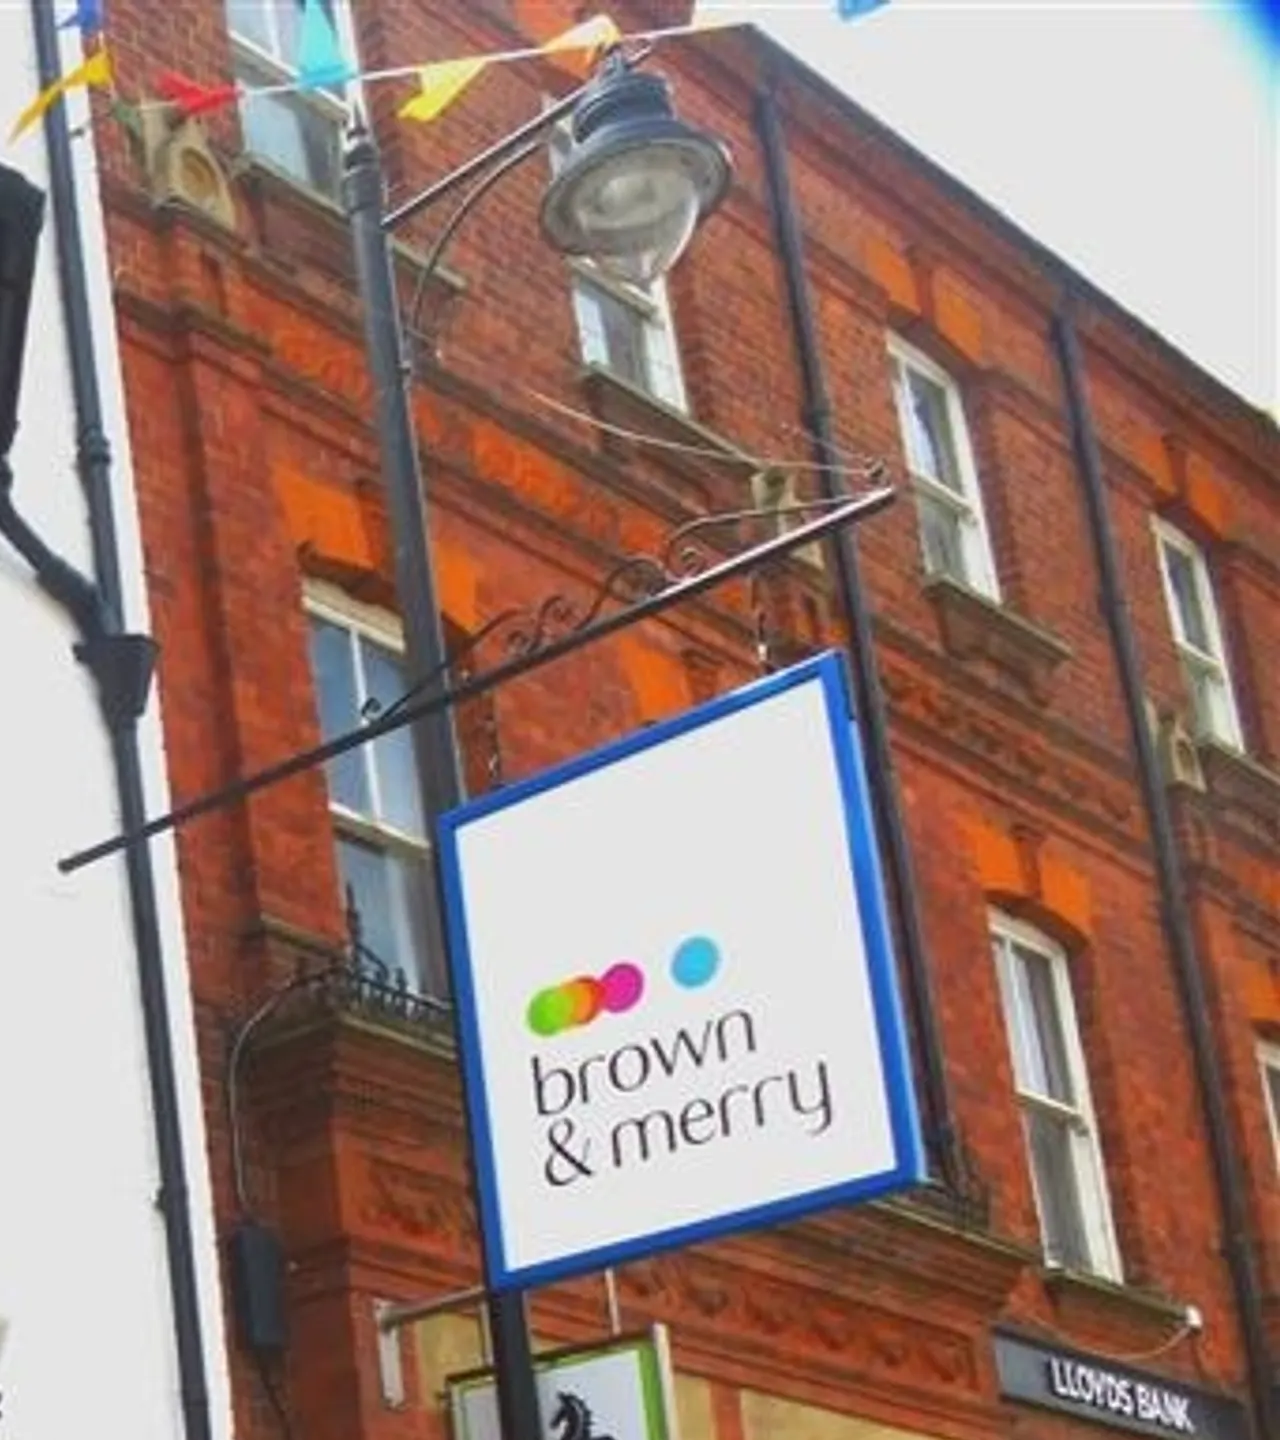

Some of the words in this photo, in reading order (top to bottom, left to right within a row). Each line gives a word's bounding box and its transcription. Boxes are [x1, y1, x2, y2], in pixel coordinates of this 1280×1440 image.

[530, 1008, 757, 1118] brown
[544, 1117, 595, 1188] &
[611, 1061, 833, 1168] merry
[1050, 1356, 1132, 1416] LLOYDS
[1137, 1382, 1197, 1435] BANK
